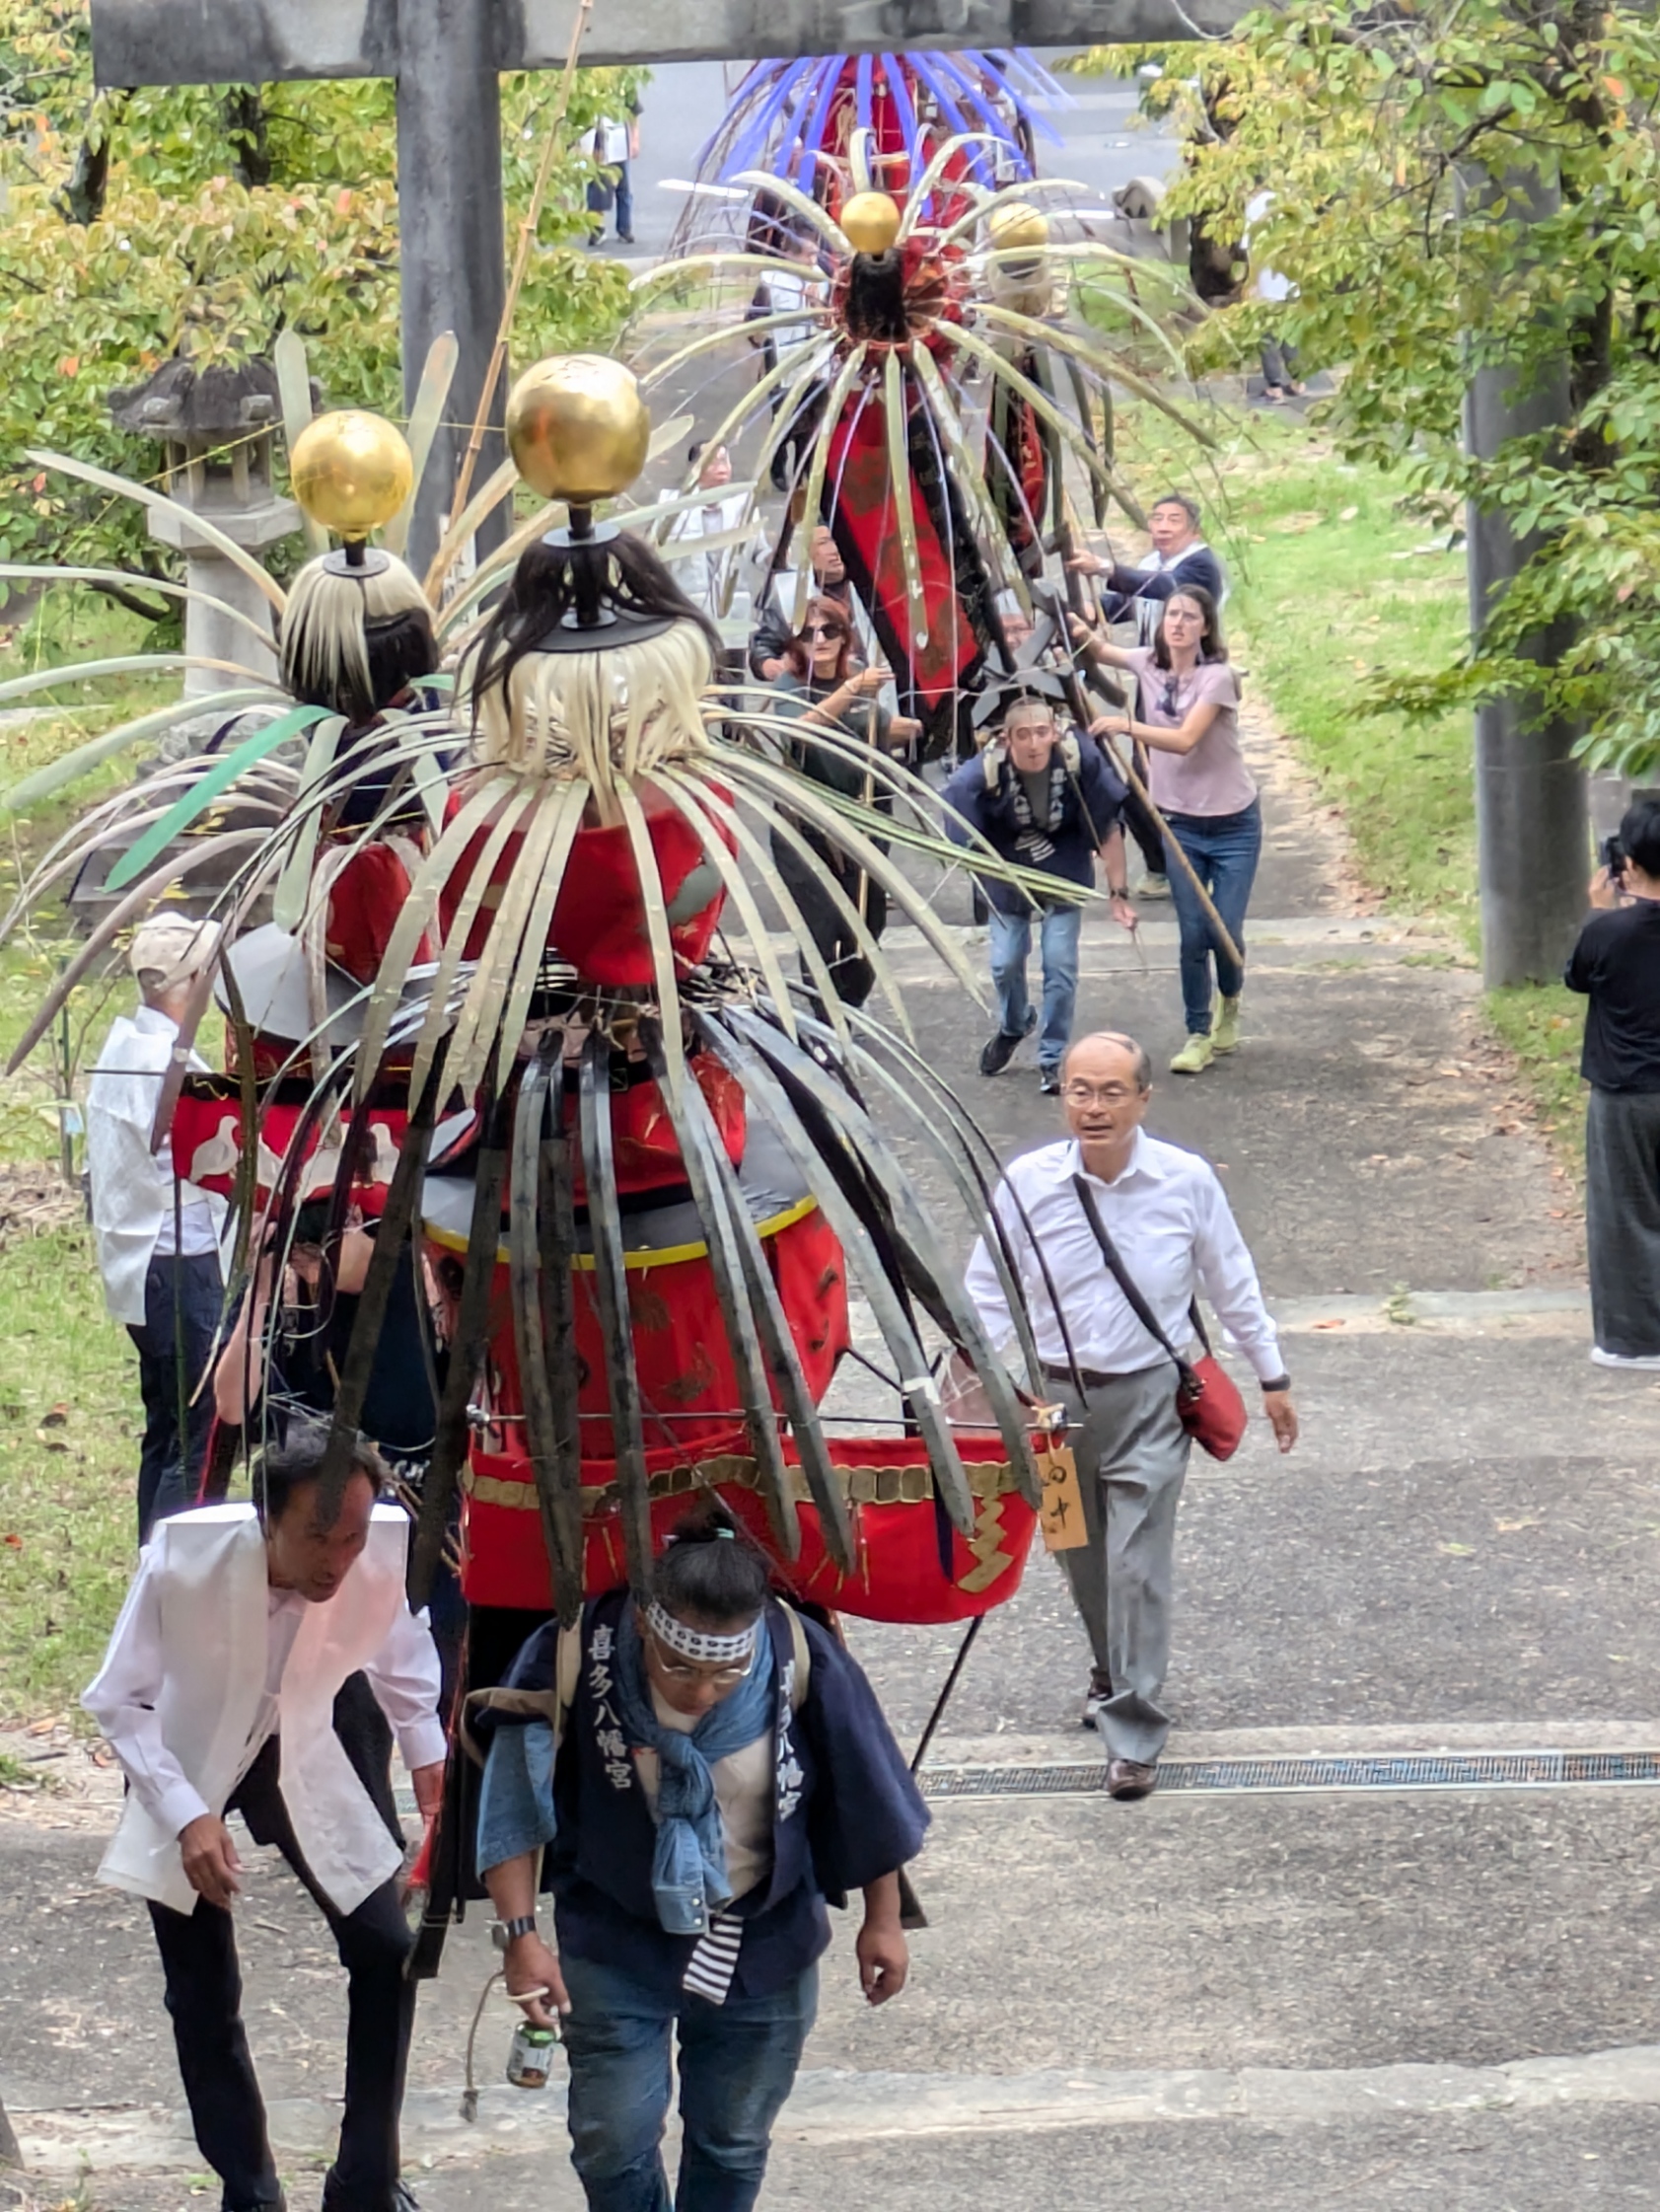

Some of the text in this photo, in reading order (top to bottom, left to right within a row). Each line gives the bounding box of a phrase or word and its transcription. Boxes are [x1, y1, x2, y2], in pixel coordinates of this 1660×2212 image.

[588, 1624, 632, 1790] 喜多八幡宮
